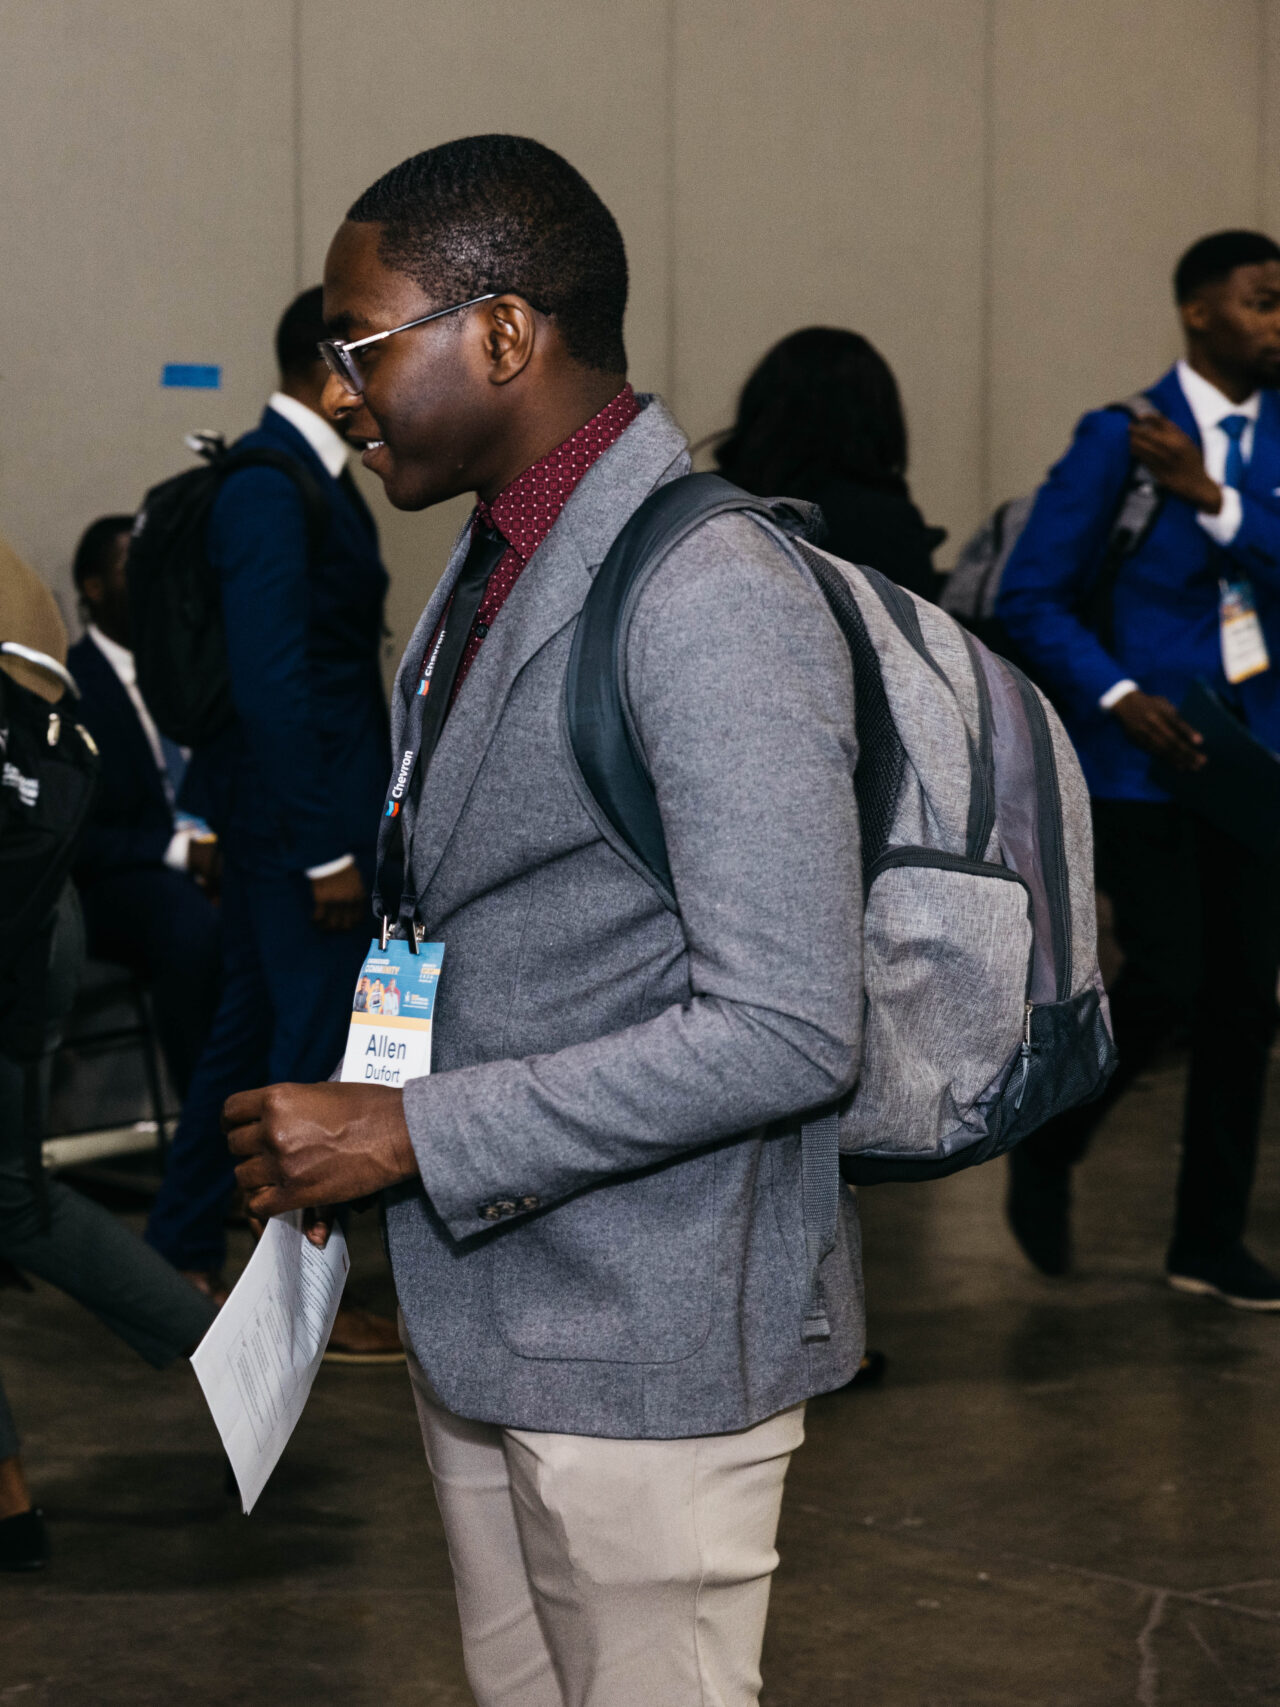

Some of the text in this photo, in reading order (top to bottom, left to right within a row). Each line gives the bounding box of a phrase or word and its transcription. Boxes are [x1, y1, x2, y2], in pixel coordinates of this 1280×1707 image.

[424, 630, 447, 677] Chevron
[391, 750, 414, 799] Chevron
[365, 1033, 407, 1060] Allen
[365, 1063, 400, 1083] Dufort
